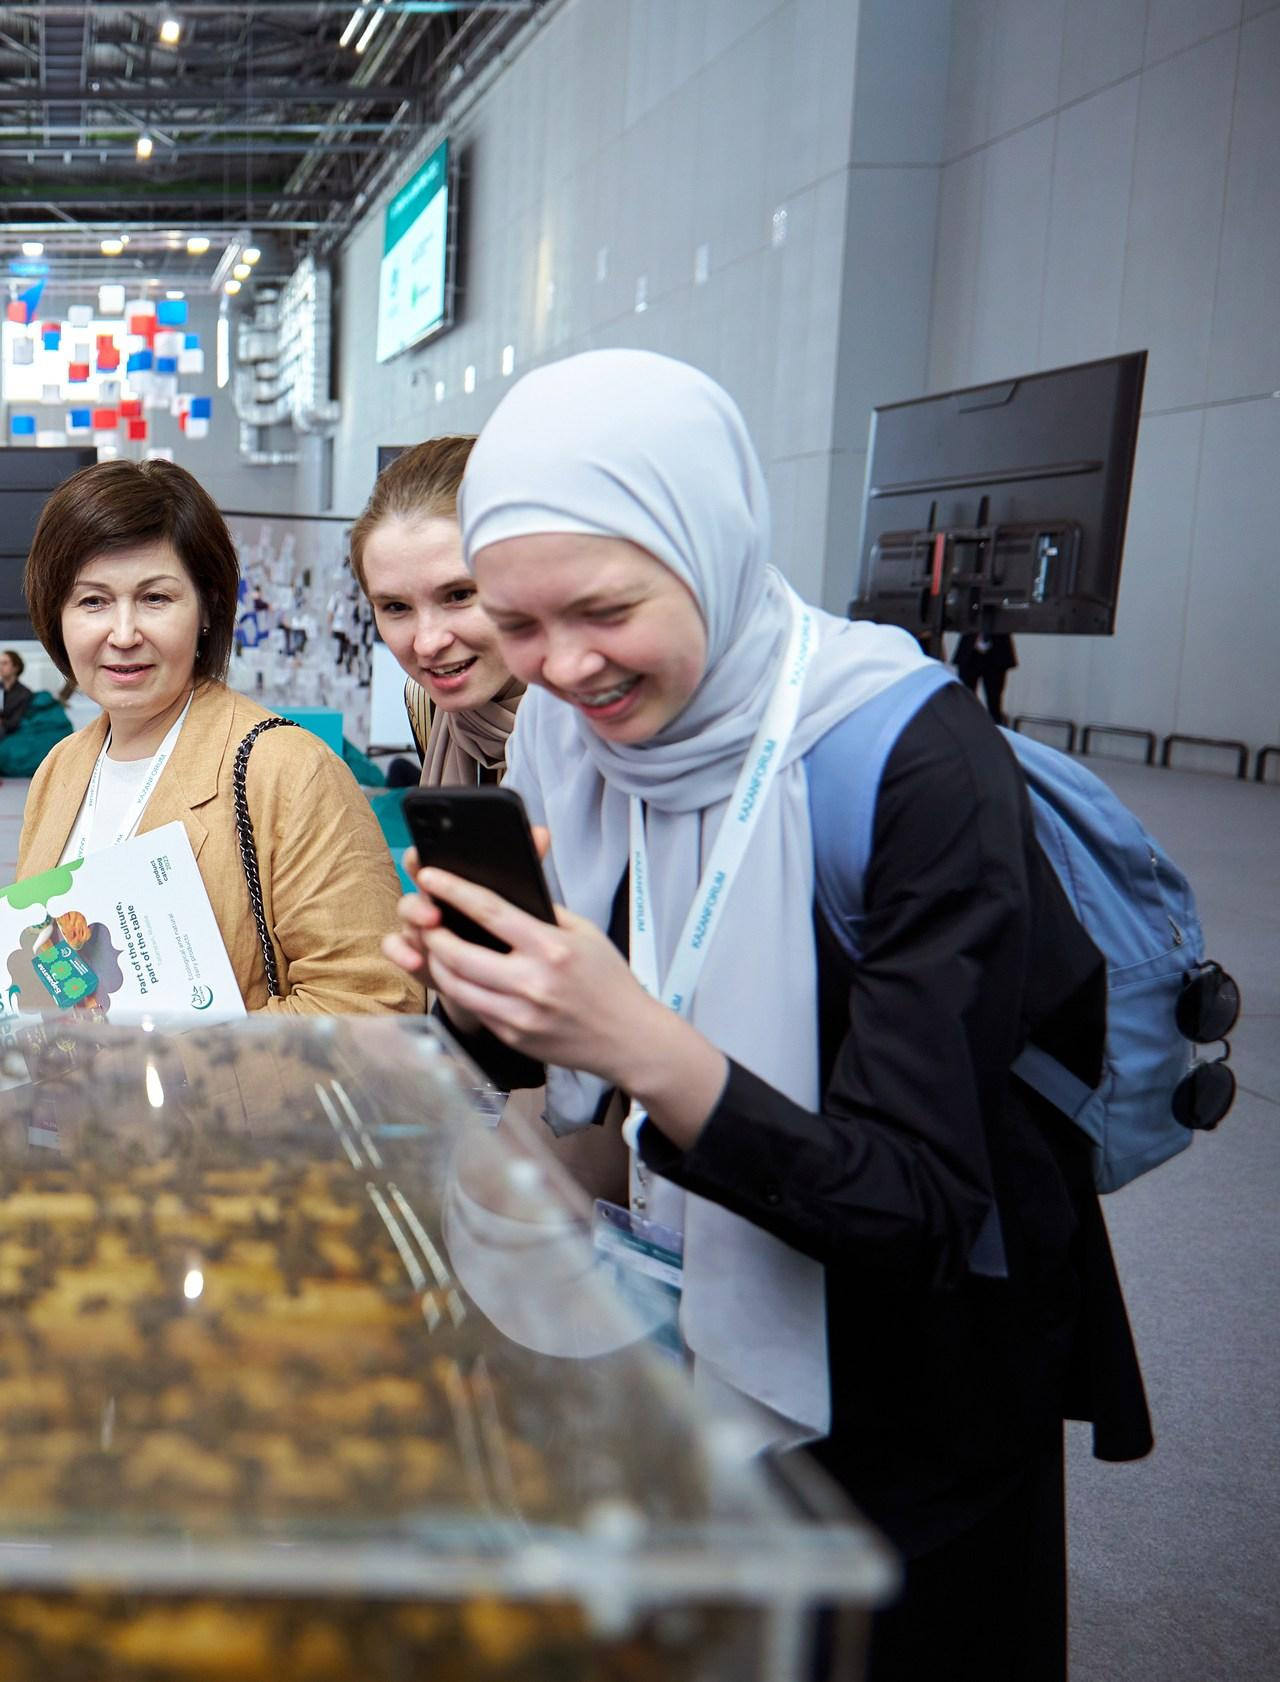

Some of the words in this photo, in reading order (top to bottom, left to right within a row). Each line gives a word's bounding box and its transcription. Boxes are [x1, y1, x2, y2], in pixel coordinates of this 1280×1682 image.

[789, 613, 810, 686] KAZANFORUM
[137, 753, 167, 804] KAZANFORUM
[737, 739, 776, 824] KAZANFORUM
[150, 859, 164, 886] product
[156, 857, 169, 882] catalog
[635, 851, 646, 932] KAZANFORUM
[115, 901, 131, 940] culture,
[127, 905, 140, 931] table
[690, 870, 727, 950] KAZANFORUM
[127, 942, 137, 959] the
[136, 932, 146, 949] the
[175, 935, 184, 949] and
[131, 961, 141, 972] of
[139, 951, 150, 962] of
[136, 972, 148, 994] Part
[145, 962, 159, 984] part
